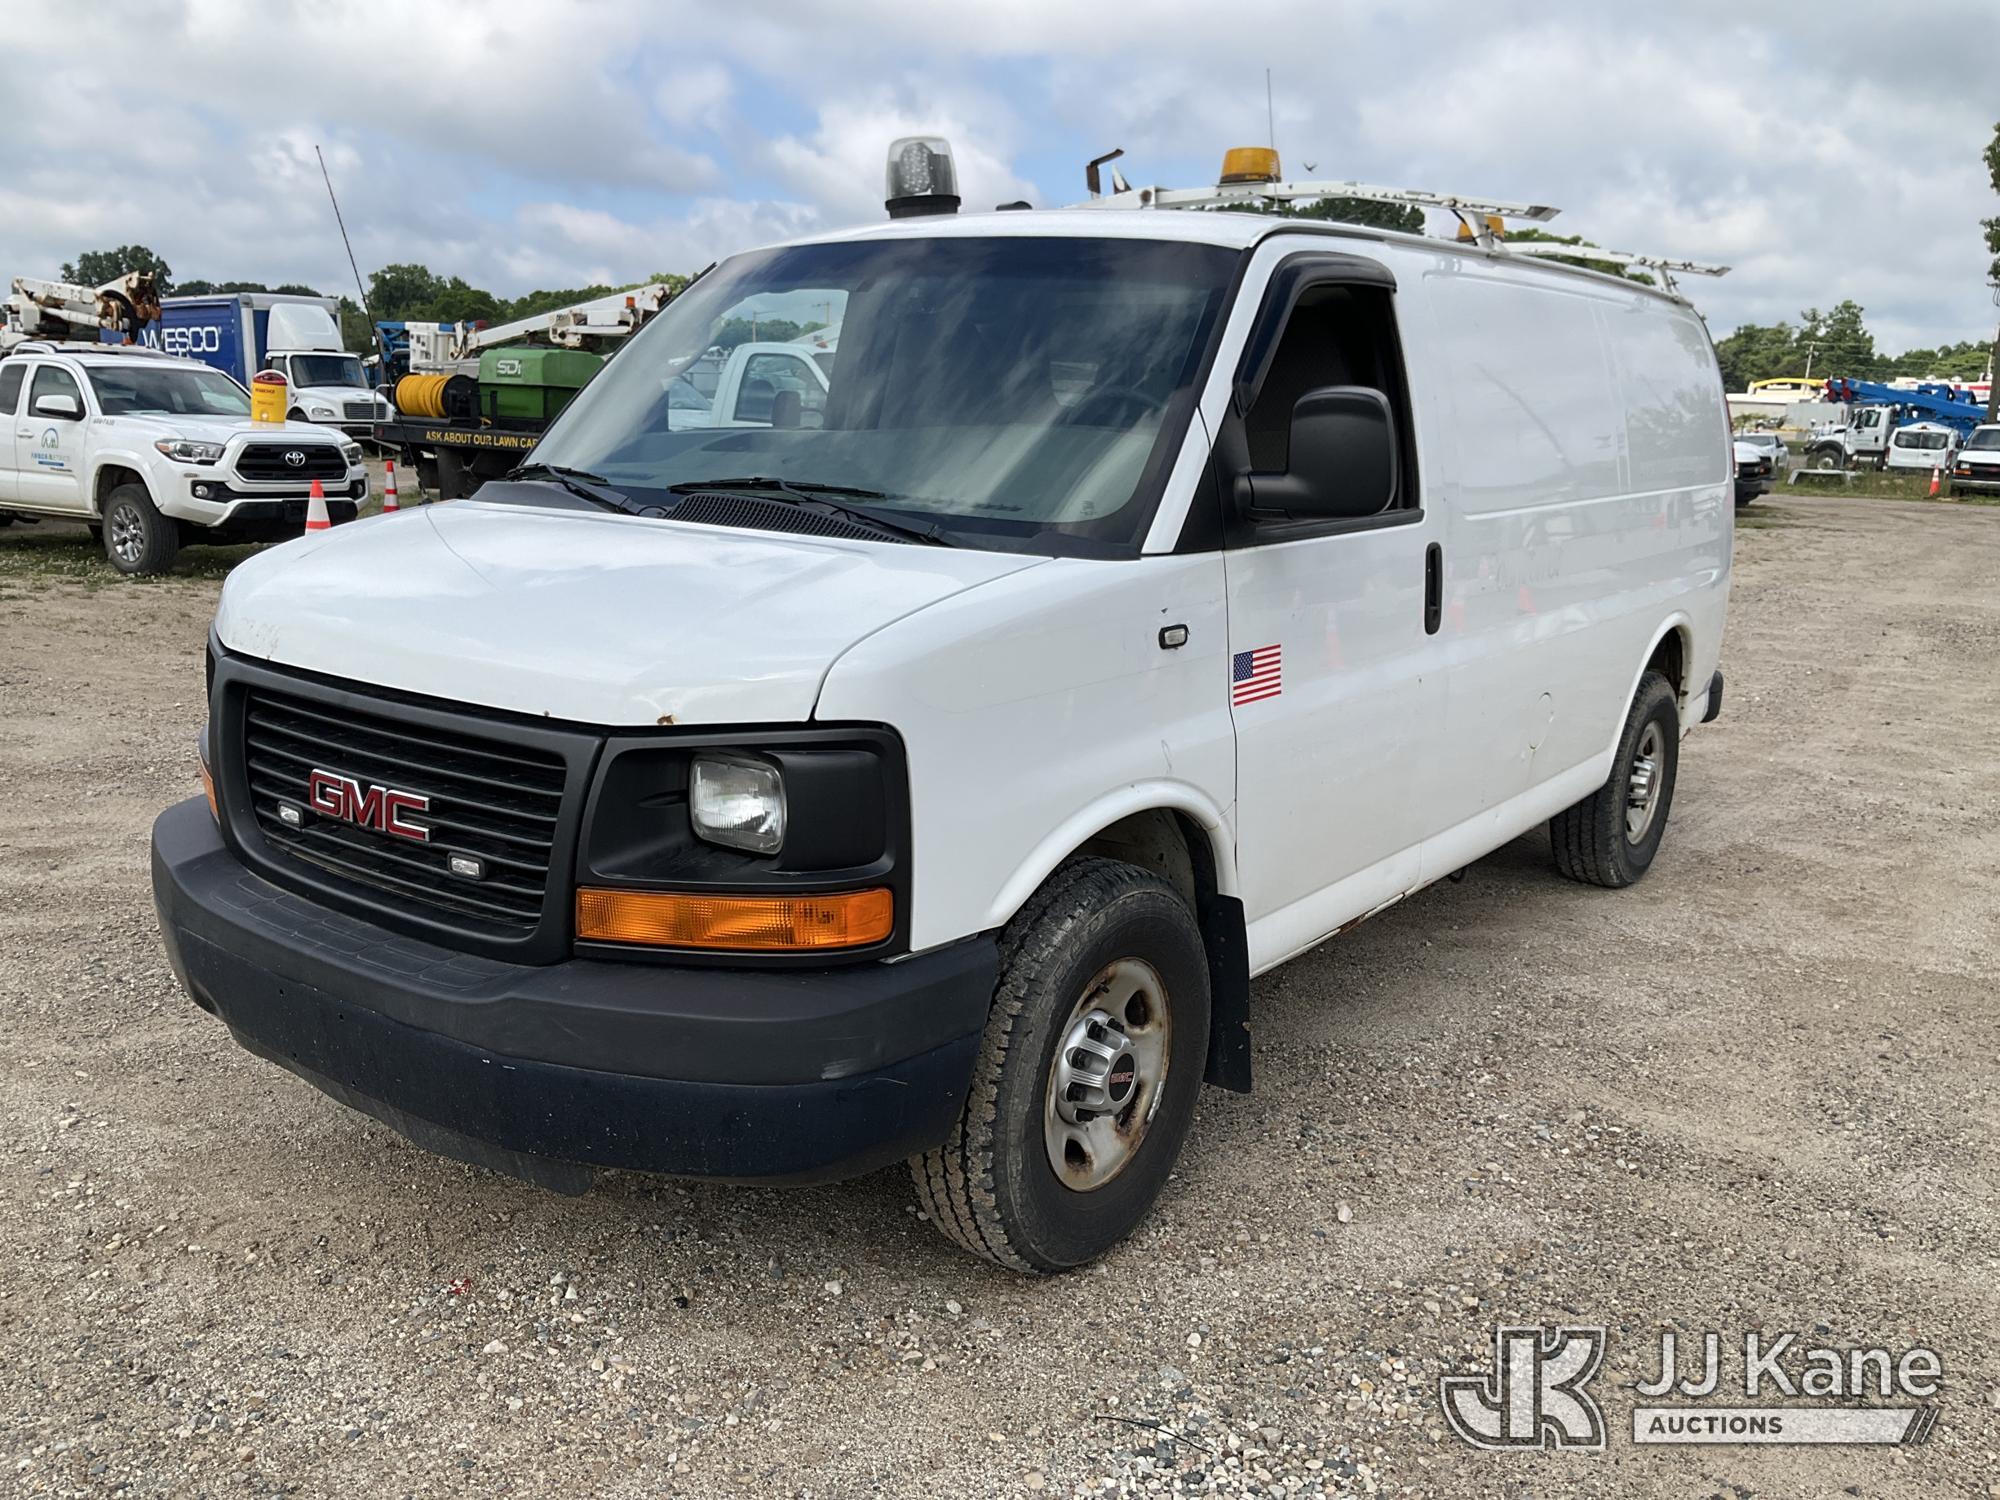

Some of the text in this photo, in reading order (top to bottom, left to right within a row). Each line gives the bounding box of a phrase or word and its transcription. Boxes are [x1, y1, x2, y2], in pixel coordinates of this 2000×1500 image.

[142, 326, 219, 352] WESCO
[426, 431, 442, 441] ASK
[444, 432, 472, 444] ABOUT
[473, 434, 492, 445] OUR
[493, 435, 518, 448] LAWN
[309, 768, 430, 842] GMC
